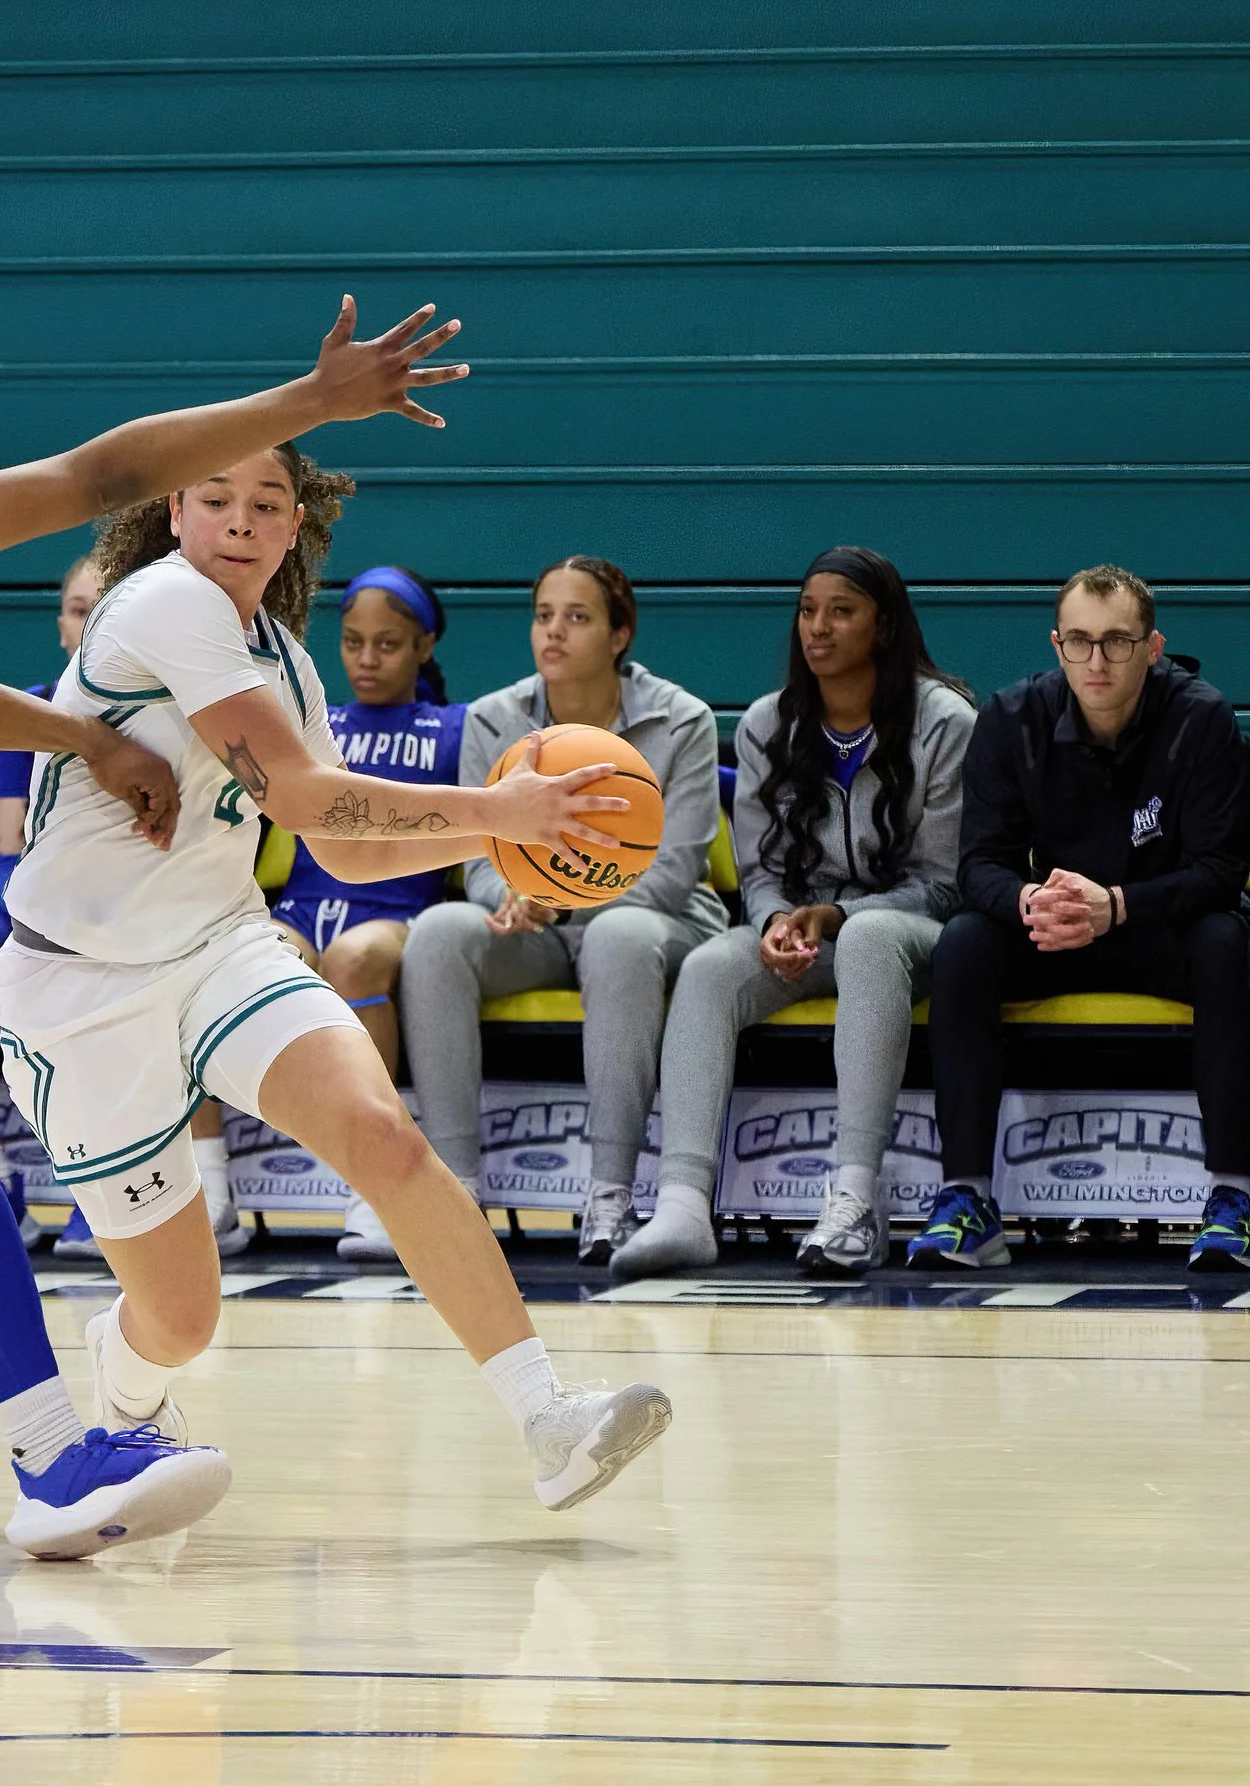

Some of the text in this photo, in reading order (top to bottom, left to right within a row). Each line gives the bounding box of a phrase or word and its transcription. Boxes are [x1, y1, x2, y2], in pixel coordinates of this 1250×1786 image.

[549, 847, 647, 889] Wilso
[1003, 1108, 1206, 1166] CAPITA
[1053, 1161, 1100, 1179] Ford
[1023, 1183, 1211, 1203] WILMINGTON
